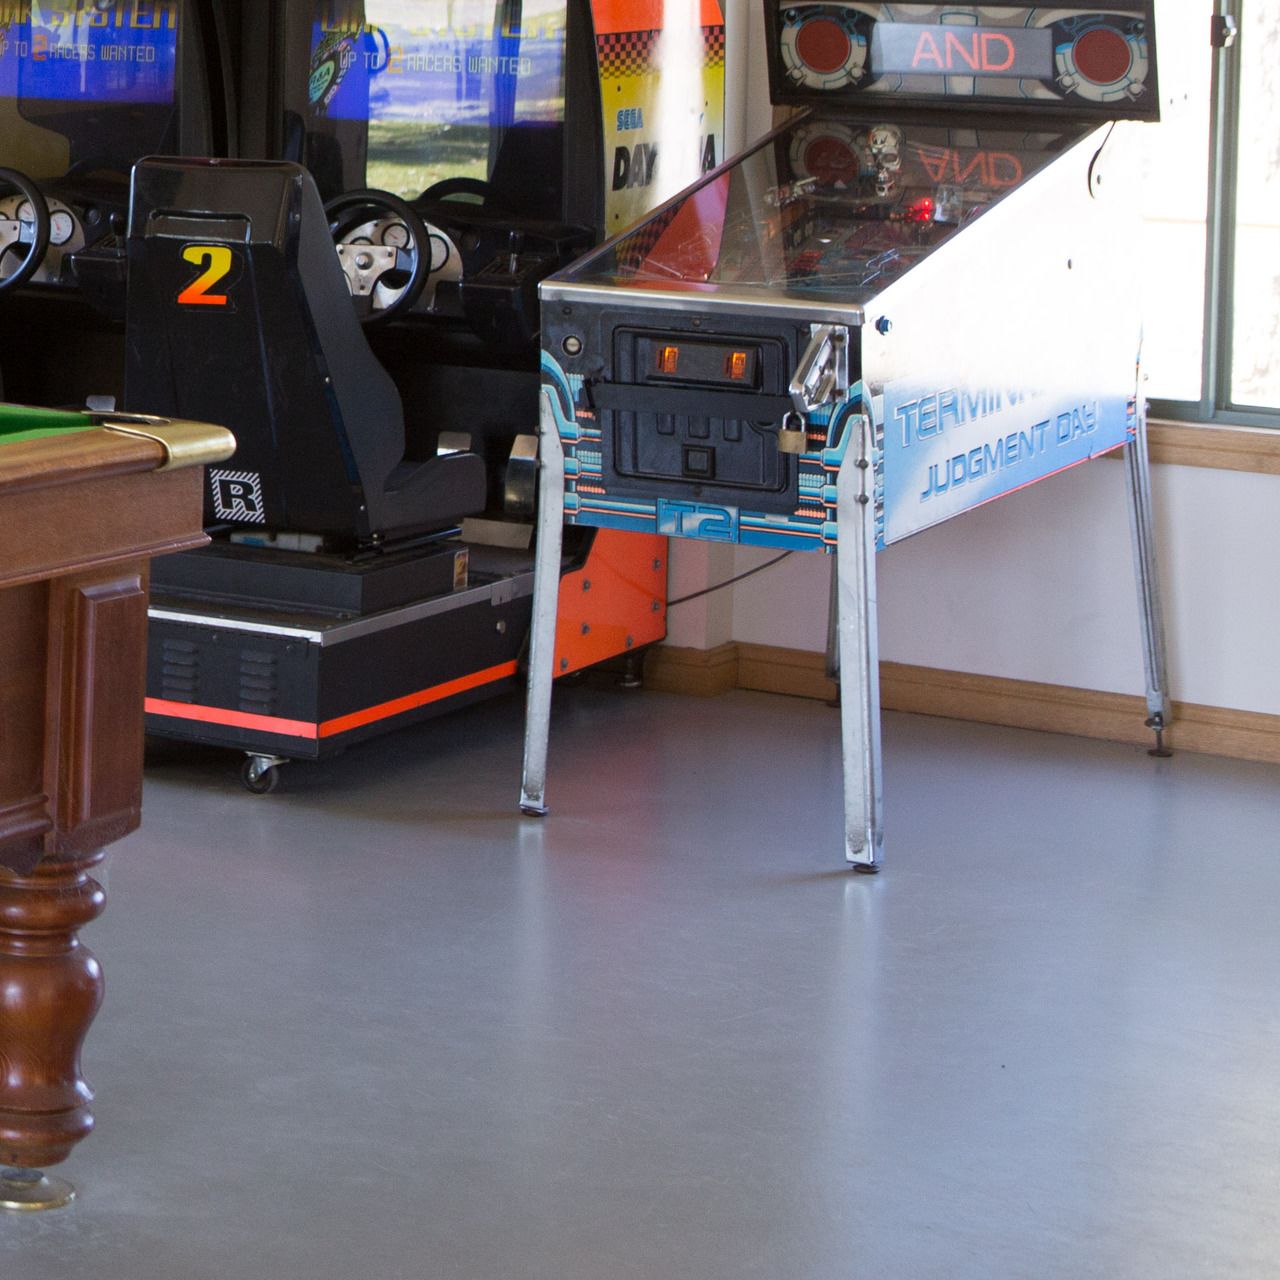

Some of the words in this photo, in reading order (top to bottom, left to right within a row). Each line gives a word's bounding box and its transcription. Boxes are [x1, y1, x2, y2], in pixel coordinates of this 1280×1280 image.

[13, 42, 28, 57] TO
[32, 34, 48, 62] 2
[100, 45, 155, 63] WANTED
[339, 51, 357, 69] UP
[363, 52, 380, 70] TO
[388, 45, 404, 74] 2
[468, 56, 532, 75] WANTED
[911, 31, 1015, 71] AND
[616, 107, 644, 132] SEGA
[177, 245, 232, 306] 2
[920, 419, 1051, 504] JUDGMENT
[1056, 399, 1100, 448] DAY
[217, 478, 260, 514] R
[659, 498, 734, 541] T2
